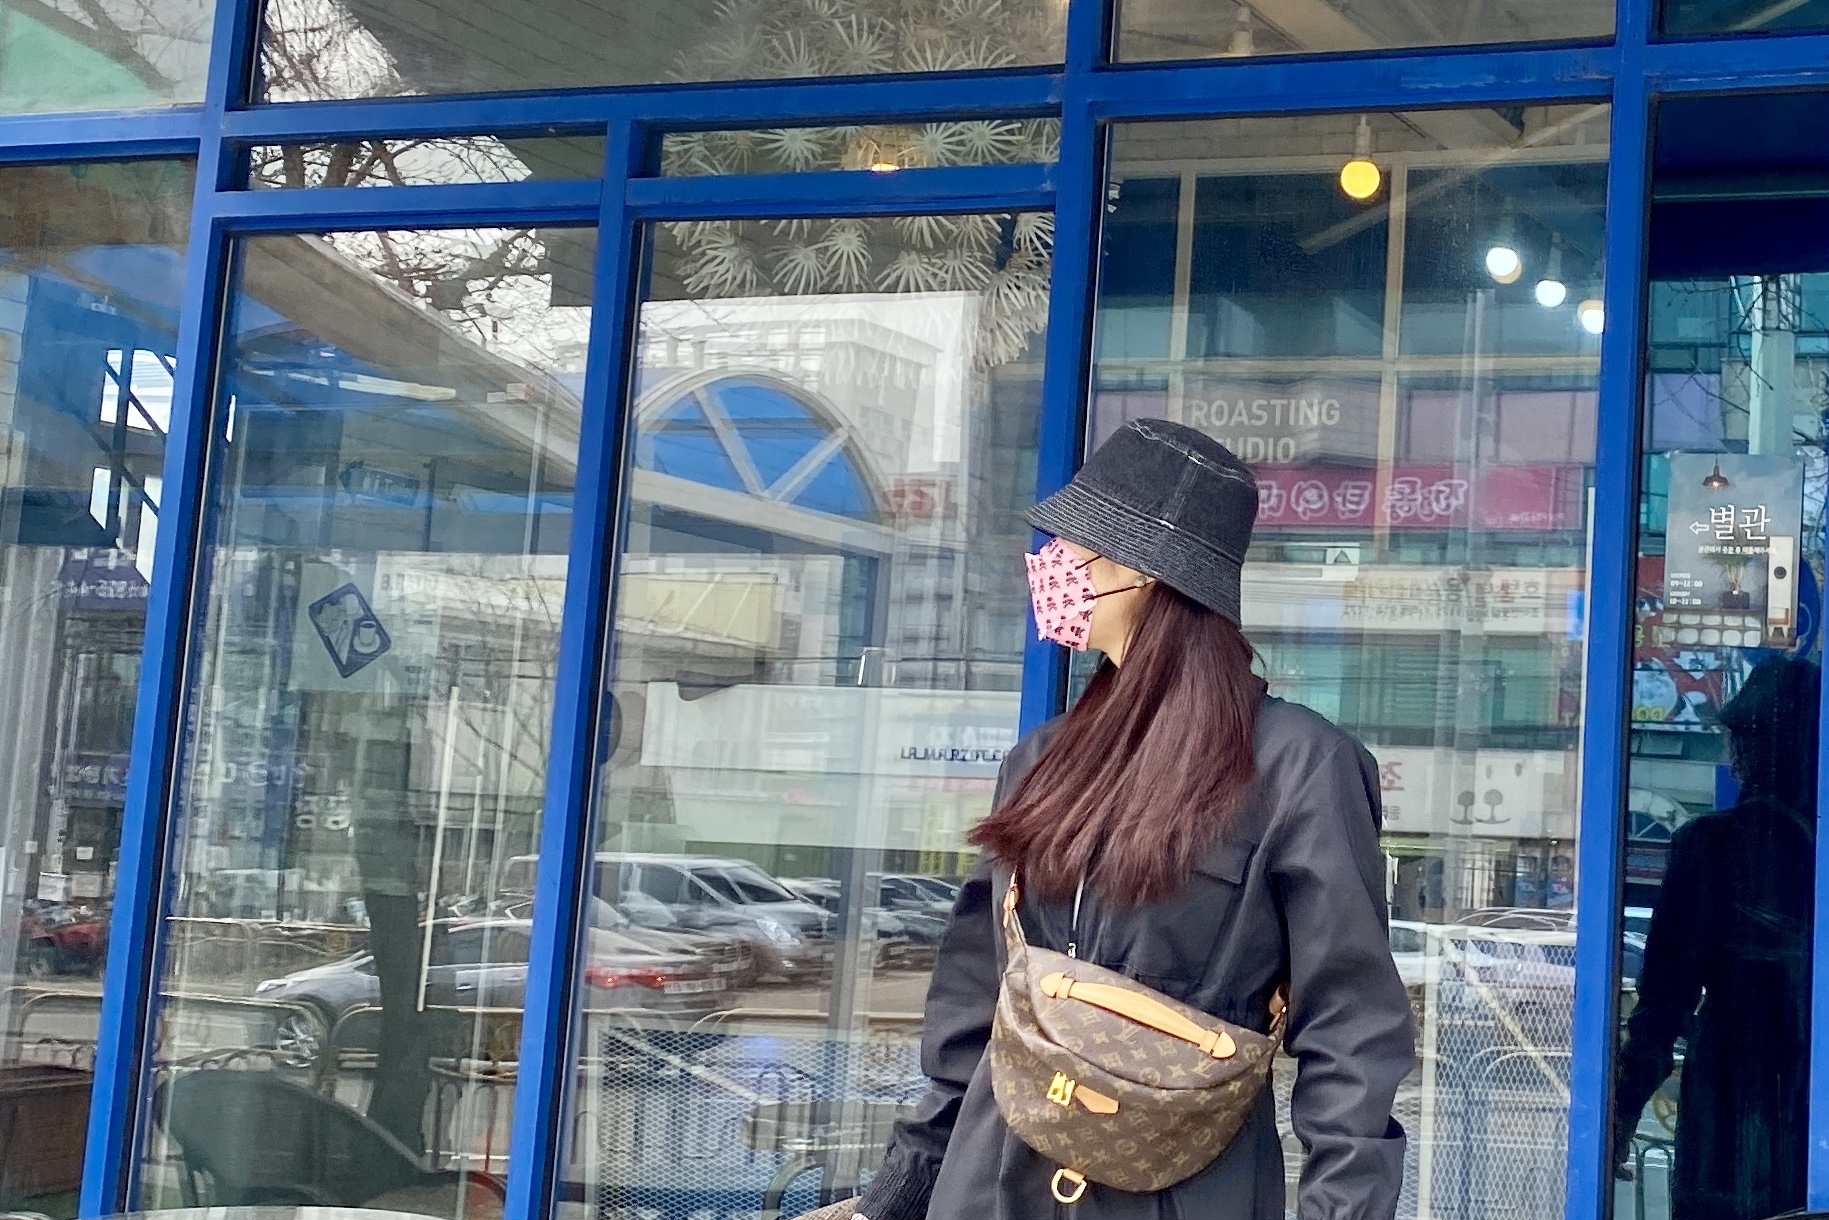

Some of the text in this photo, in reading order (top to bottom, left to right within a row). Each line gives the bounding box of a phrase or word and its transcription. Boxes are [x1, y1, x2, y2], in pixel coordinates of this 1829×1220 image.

[1191, 398, 1341, 427] ROASTING
[1216, 437, 1296, 464] UDIO
[1709, 504, 1772, 540] 별관
